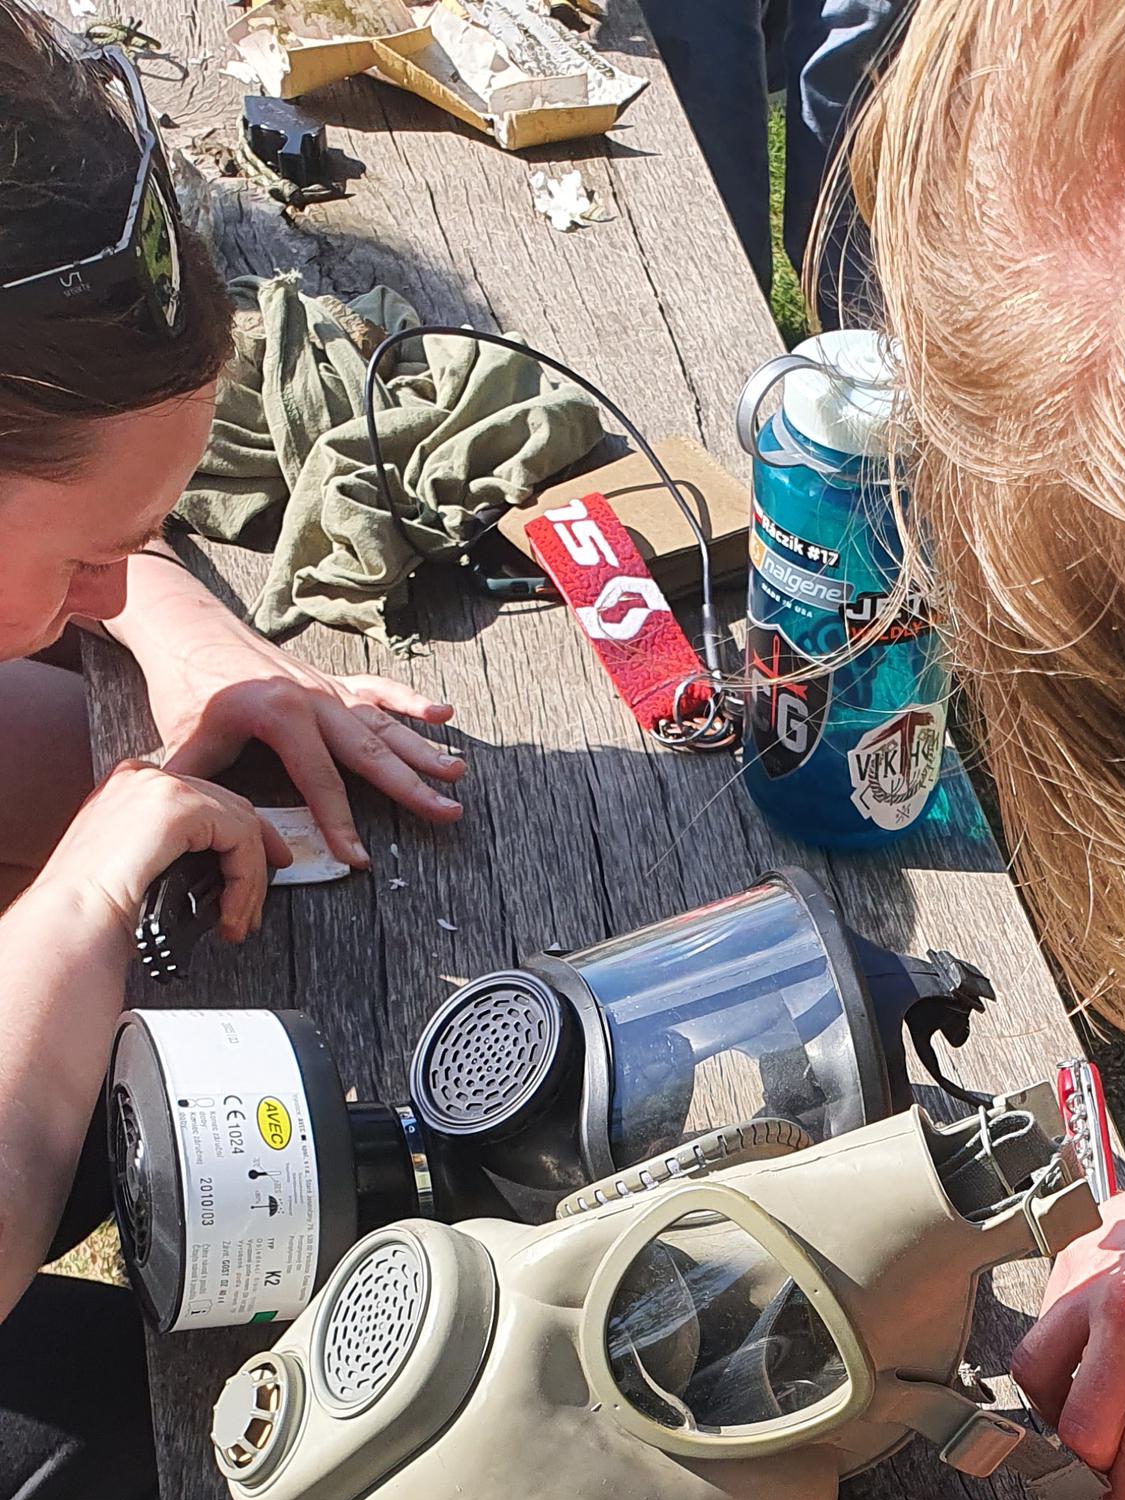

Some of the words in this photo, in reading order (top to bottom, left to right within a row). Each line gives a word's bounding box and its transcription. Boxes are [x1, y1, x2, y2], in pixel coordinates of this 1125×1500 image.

[760, 517, 804, 556] Ráczik
[807, 544, 839, 567] #17
[763, 556, 843, 603] nalgene
[761, 582, 781, 603] MADE
[782, 598, 793, 609] IN
[794, 604, 813, 618] USA
[228, 1124, 245, 1154] 1024
[264, 1102, 284, 1145] AVEC
[200, 1178, 214, 1226] 2010/03
[267, 1238, 275, 1249] TYP
[221, 1260, 230, 1277] GOST
[264, 1270, 282, 1286] K2
